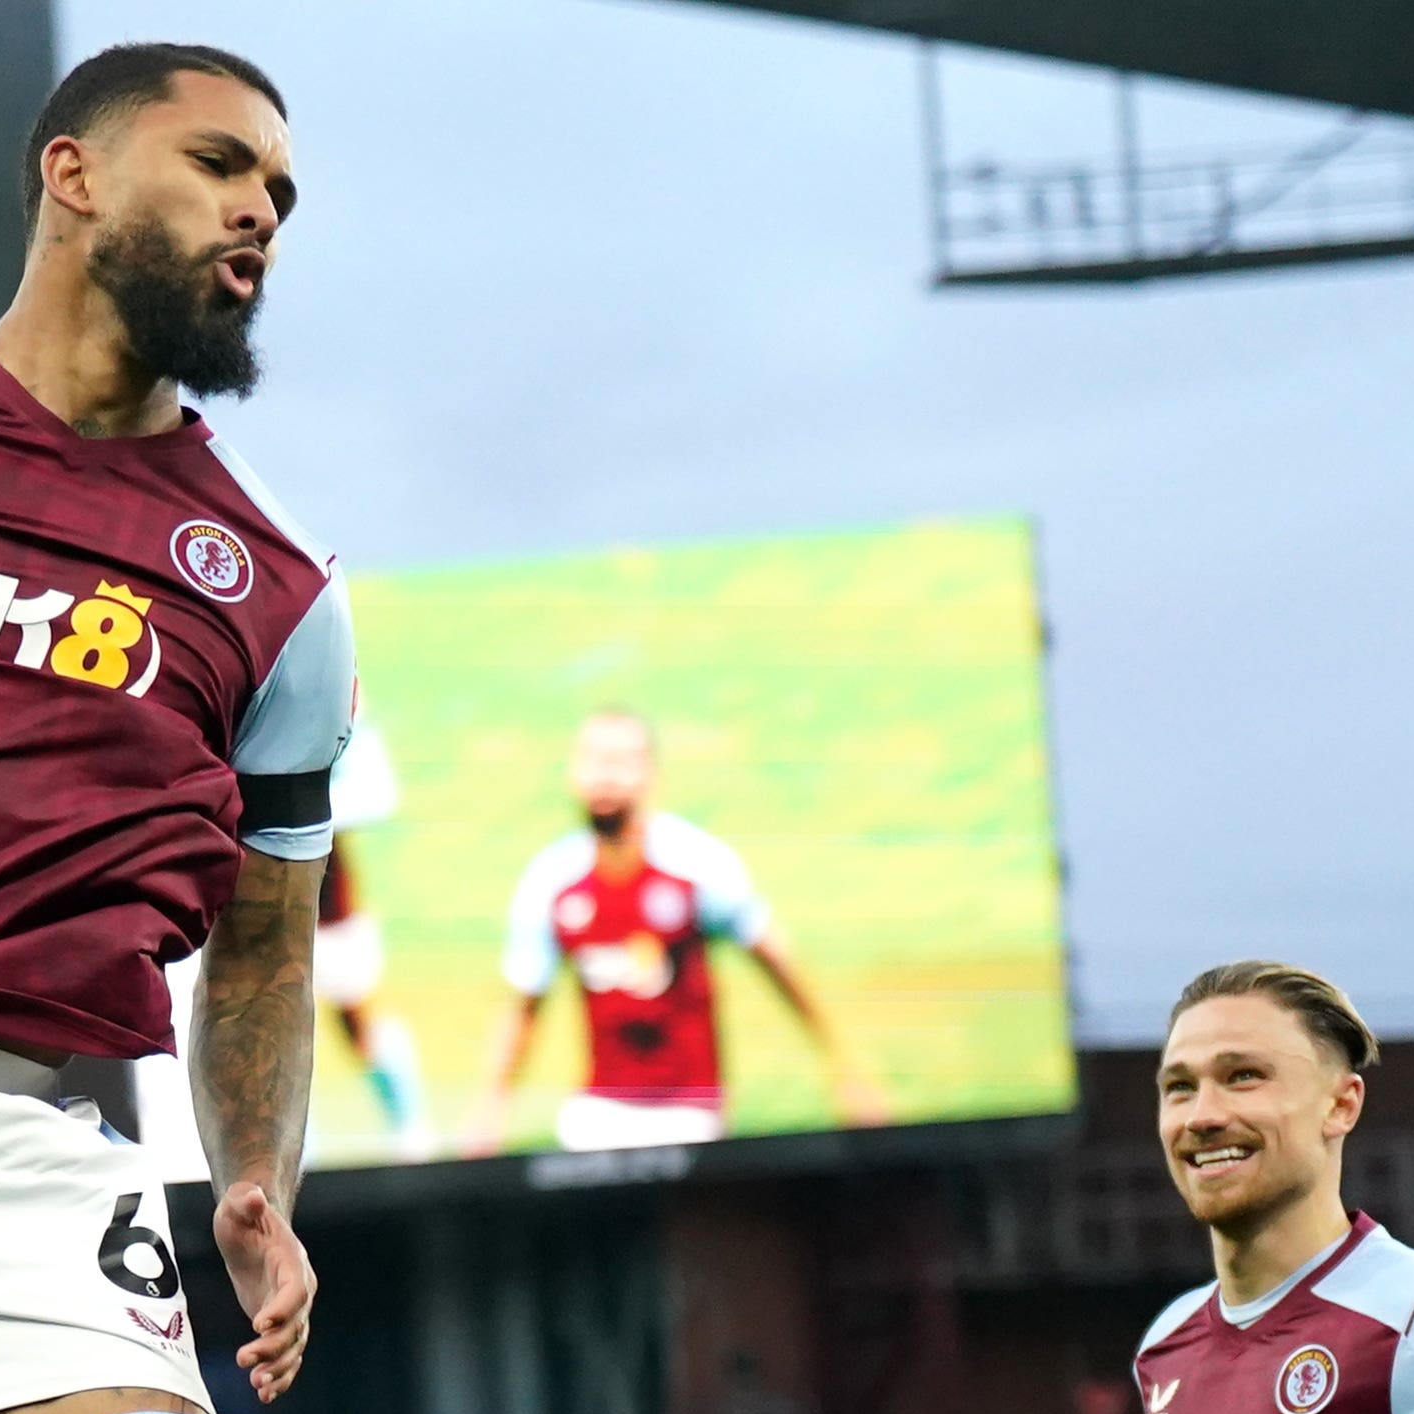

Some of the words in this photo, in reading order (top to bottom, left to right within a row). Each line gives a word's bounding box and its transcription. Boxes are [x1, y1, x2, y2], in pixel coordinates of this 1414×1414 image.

[188, 526, 222, 539] ASTON
[224, 536, 246, 567] VILLA
[98, 1192, 179, 1299] 6
